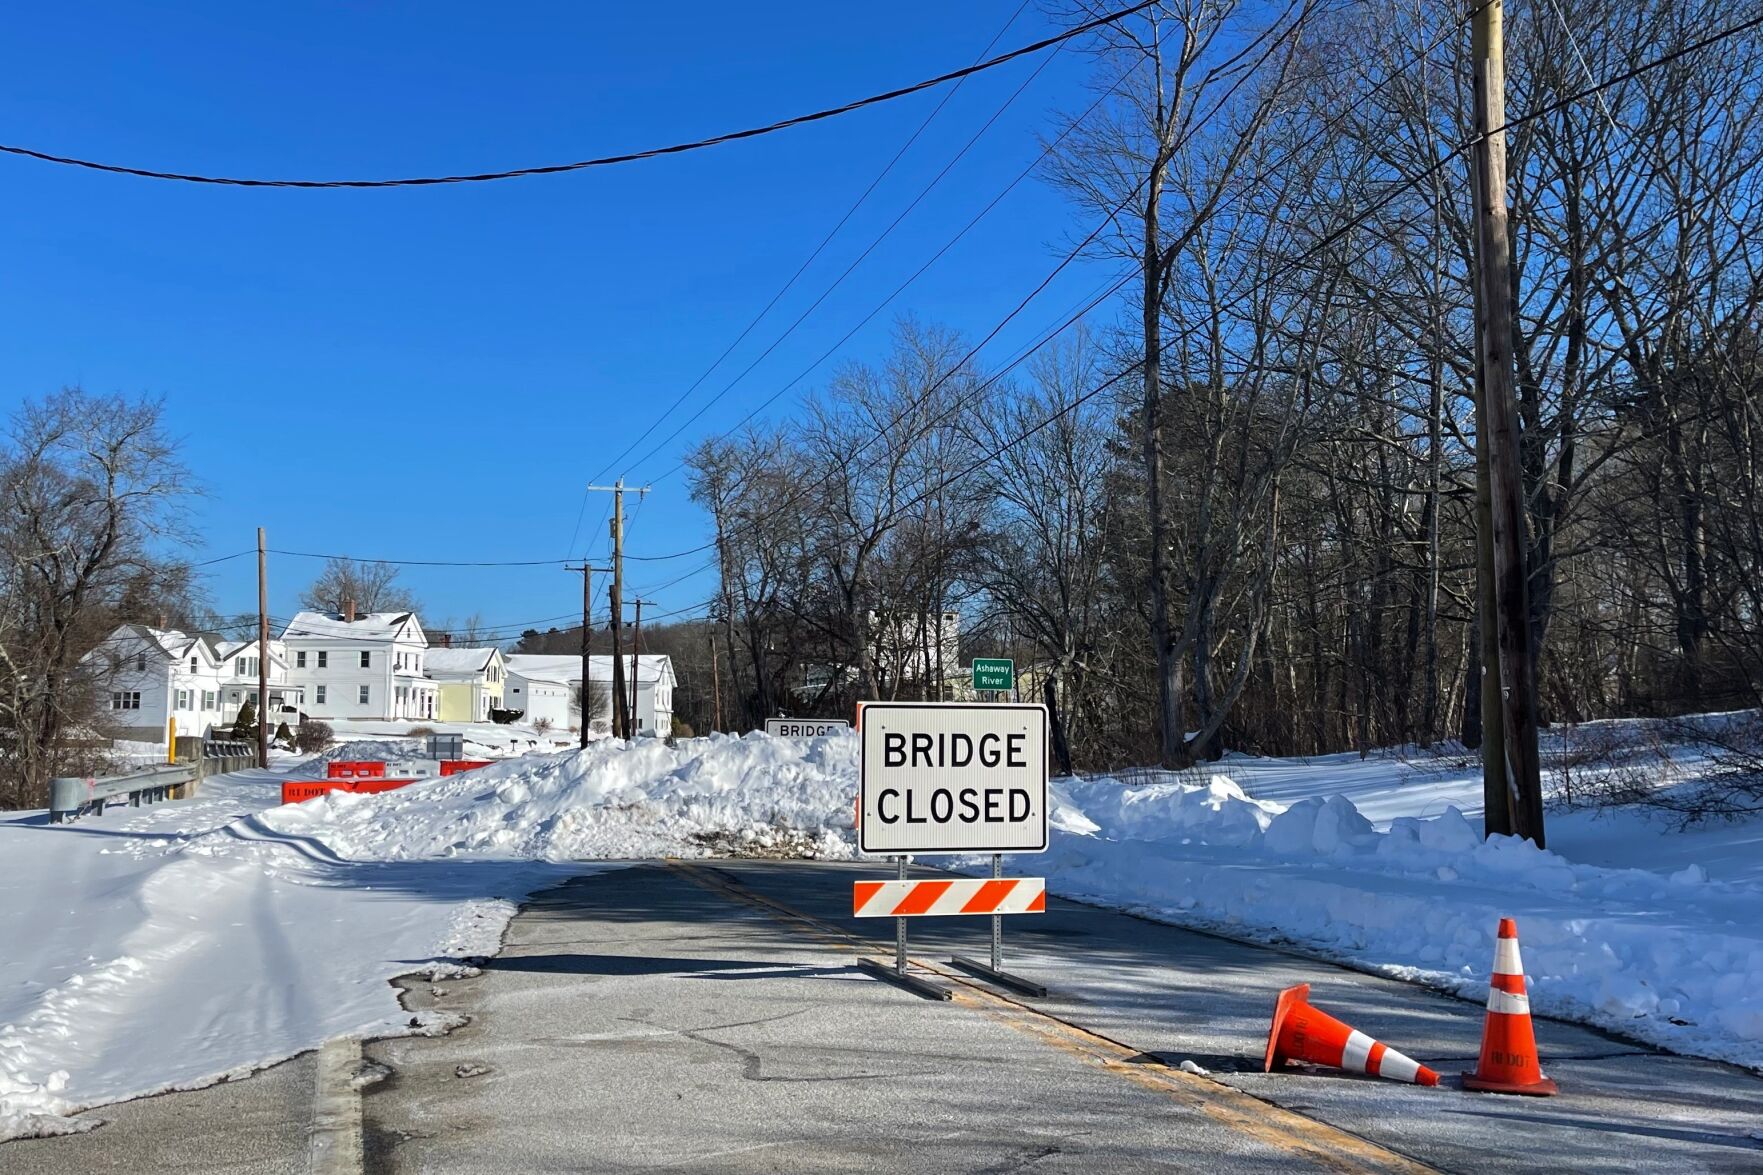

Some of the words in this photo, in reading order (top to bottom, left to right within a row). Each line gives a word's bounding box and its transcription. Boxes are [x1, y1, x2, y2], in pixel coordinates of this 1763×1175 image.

[976, 663, 1010, 674] Ashaway
[981, 676, 1004, 685] River
[884, 732, 1027, 768] BRIDGE
[288, 788, 300, 797] RI
[304, 788, 325, 797] DOT
[877, 788, 1031, 824] CLOSED
[1506, 1053, 1530, 1068] DOT
